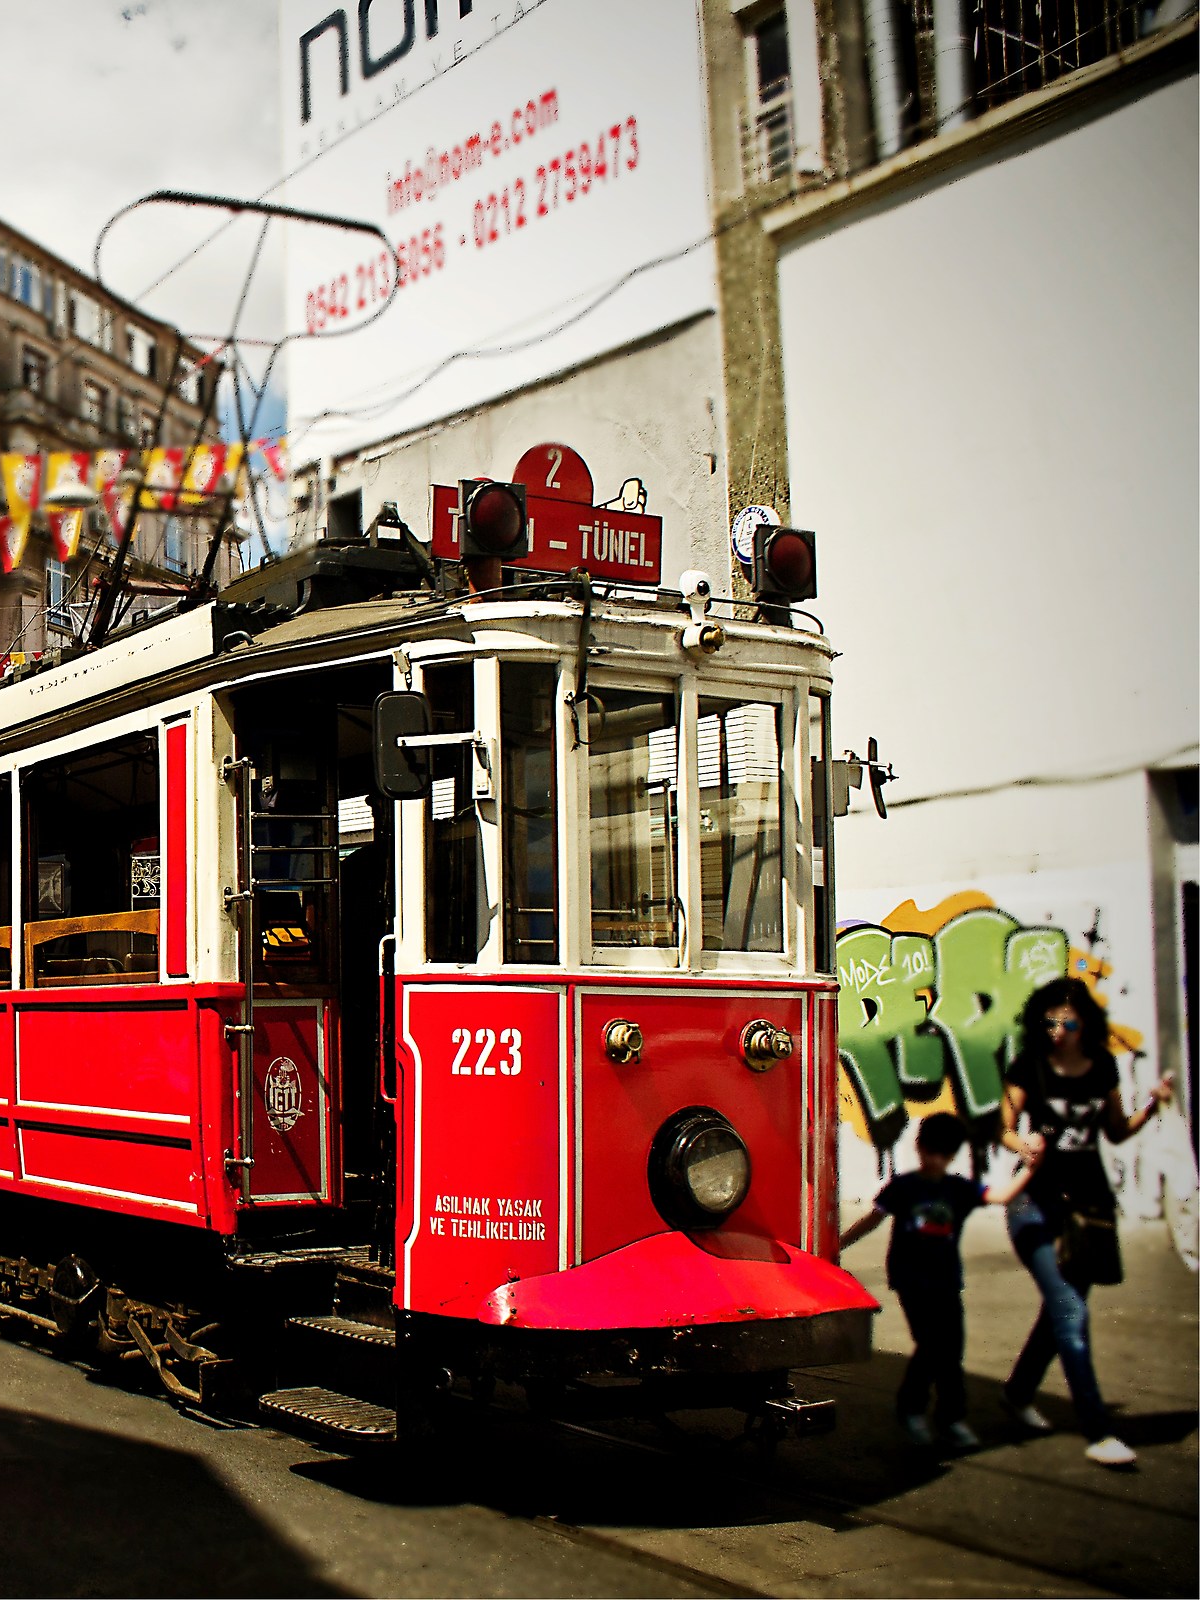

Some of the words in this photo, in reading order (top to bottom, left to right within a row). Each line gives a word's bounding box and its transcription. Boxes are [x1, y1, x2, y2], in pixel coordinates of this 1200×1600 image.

[387, 88, 559, 216] info@nom-e.com
[473, 176, 527, 250] 0212
[535, 114, 640, 219] 2759473
[546, 449, 562, 489] 2
[578, 520, 654, 568] TÜNEL
[451, 1028, 522, 1076] 223
[430, 1216, 445, 1236] VE
[451, 1218, 545, 1241] TEHLİKELİDİR
[435, 1194, 490, 1216] ASILMAK
[497, 1198, 542, 1217] YASAK
